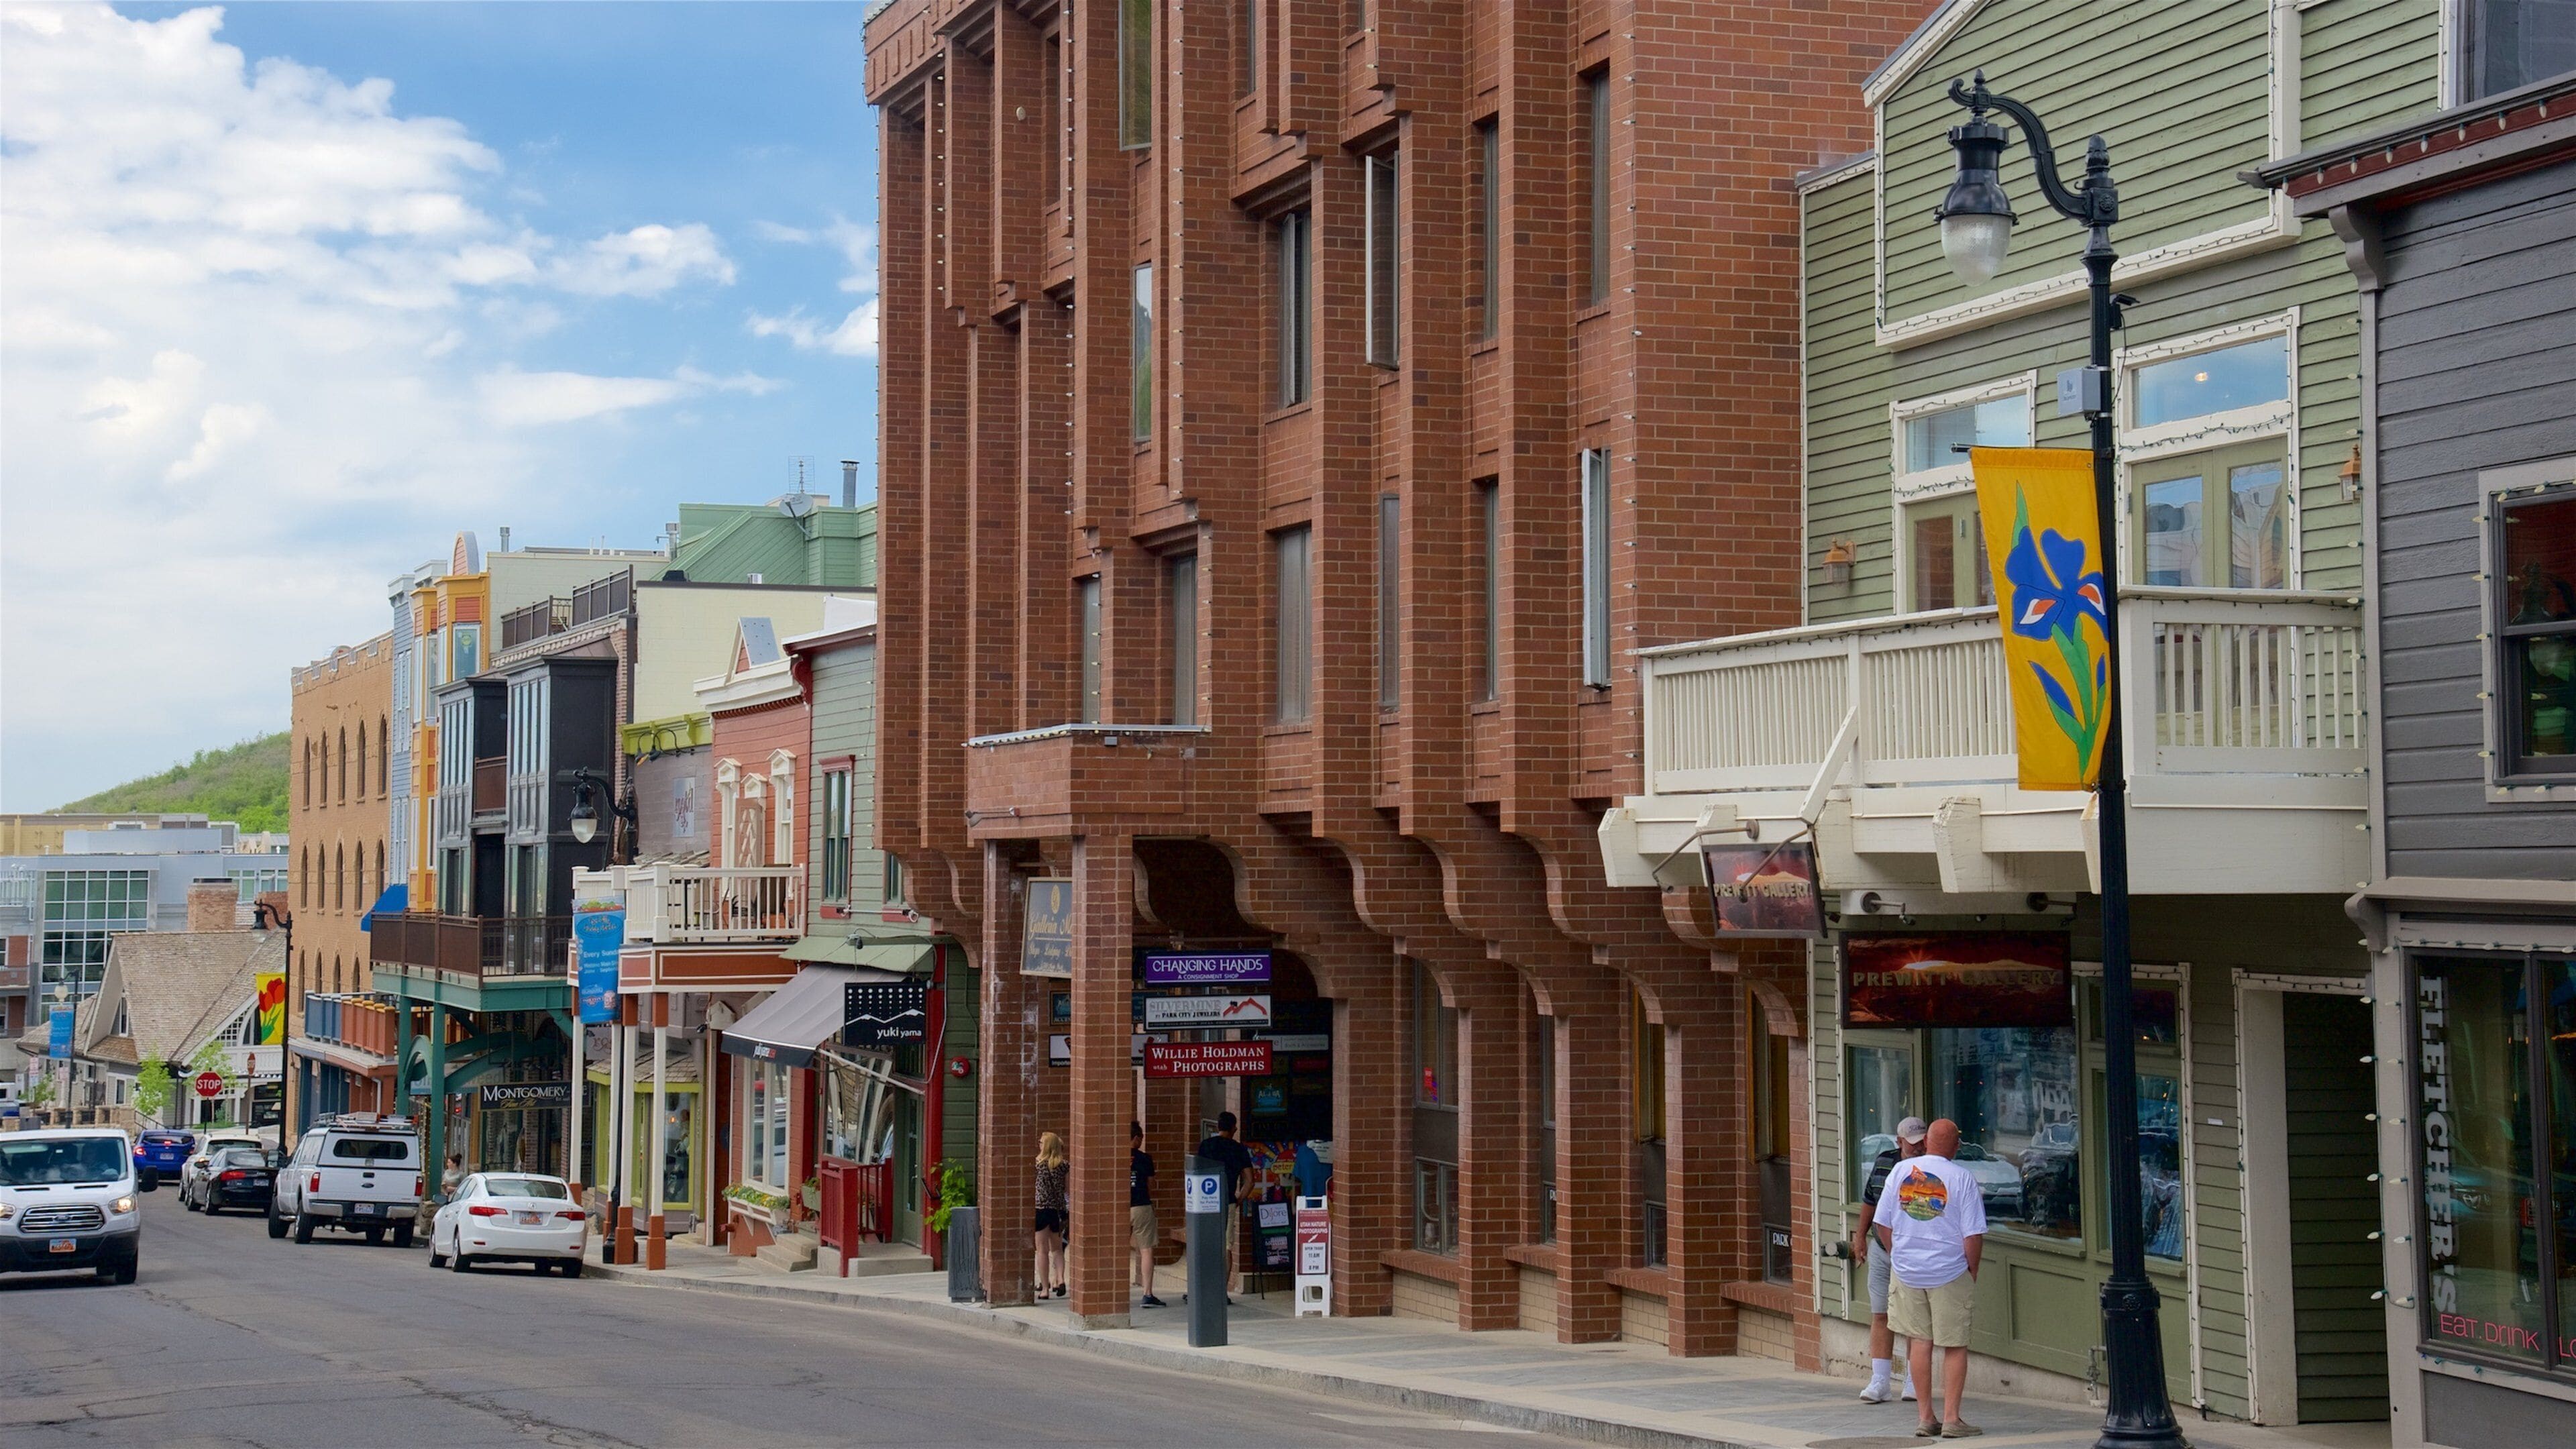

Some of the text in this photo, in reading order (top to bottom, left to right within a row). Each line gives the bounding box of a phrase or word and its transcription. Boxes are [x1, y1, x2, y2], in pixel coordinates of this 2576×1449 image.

[1713, 882, 1811, 898] PREWTT GALLERY
[583, 951, 600, 959] Every
[1152, 959, 1263, 974] CHANGING HANDS
[1853, 971, 2057, 987] PREWITT GALLERY
[1149, 1000, 1221, 1012] SILVERMINE
[877, 1027, 922, 1040] yuki yama
[1152, 1046, 1265, 1059] WILLIE HOLDMAN
[1173, 1061, 1265, 1073] PHOTOGRAPHS
[197, 1079, 221, 1089] STOP
[2420, 975, 2457, 1314] FLETCHER'S
[1205, 1181, 1214, 1192] P
[1772, 1232, 1789, 1247] PARK
